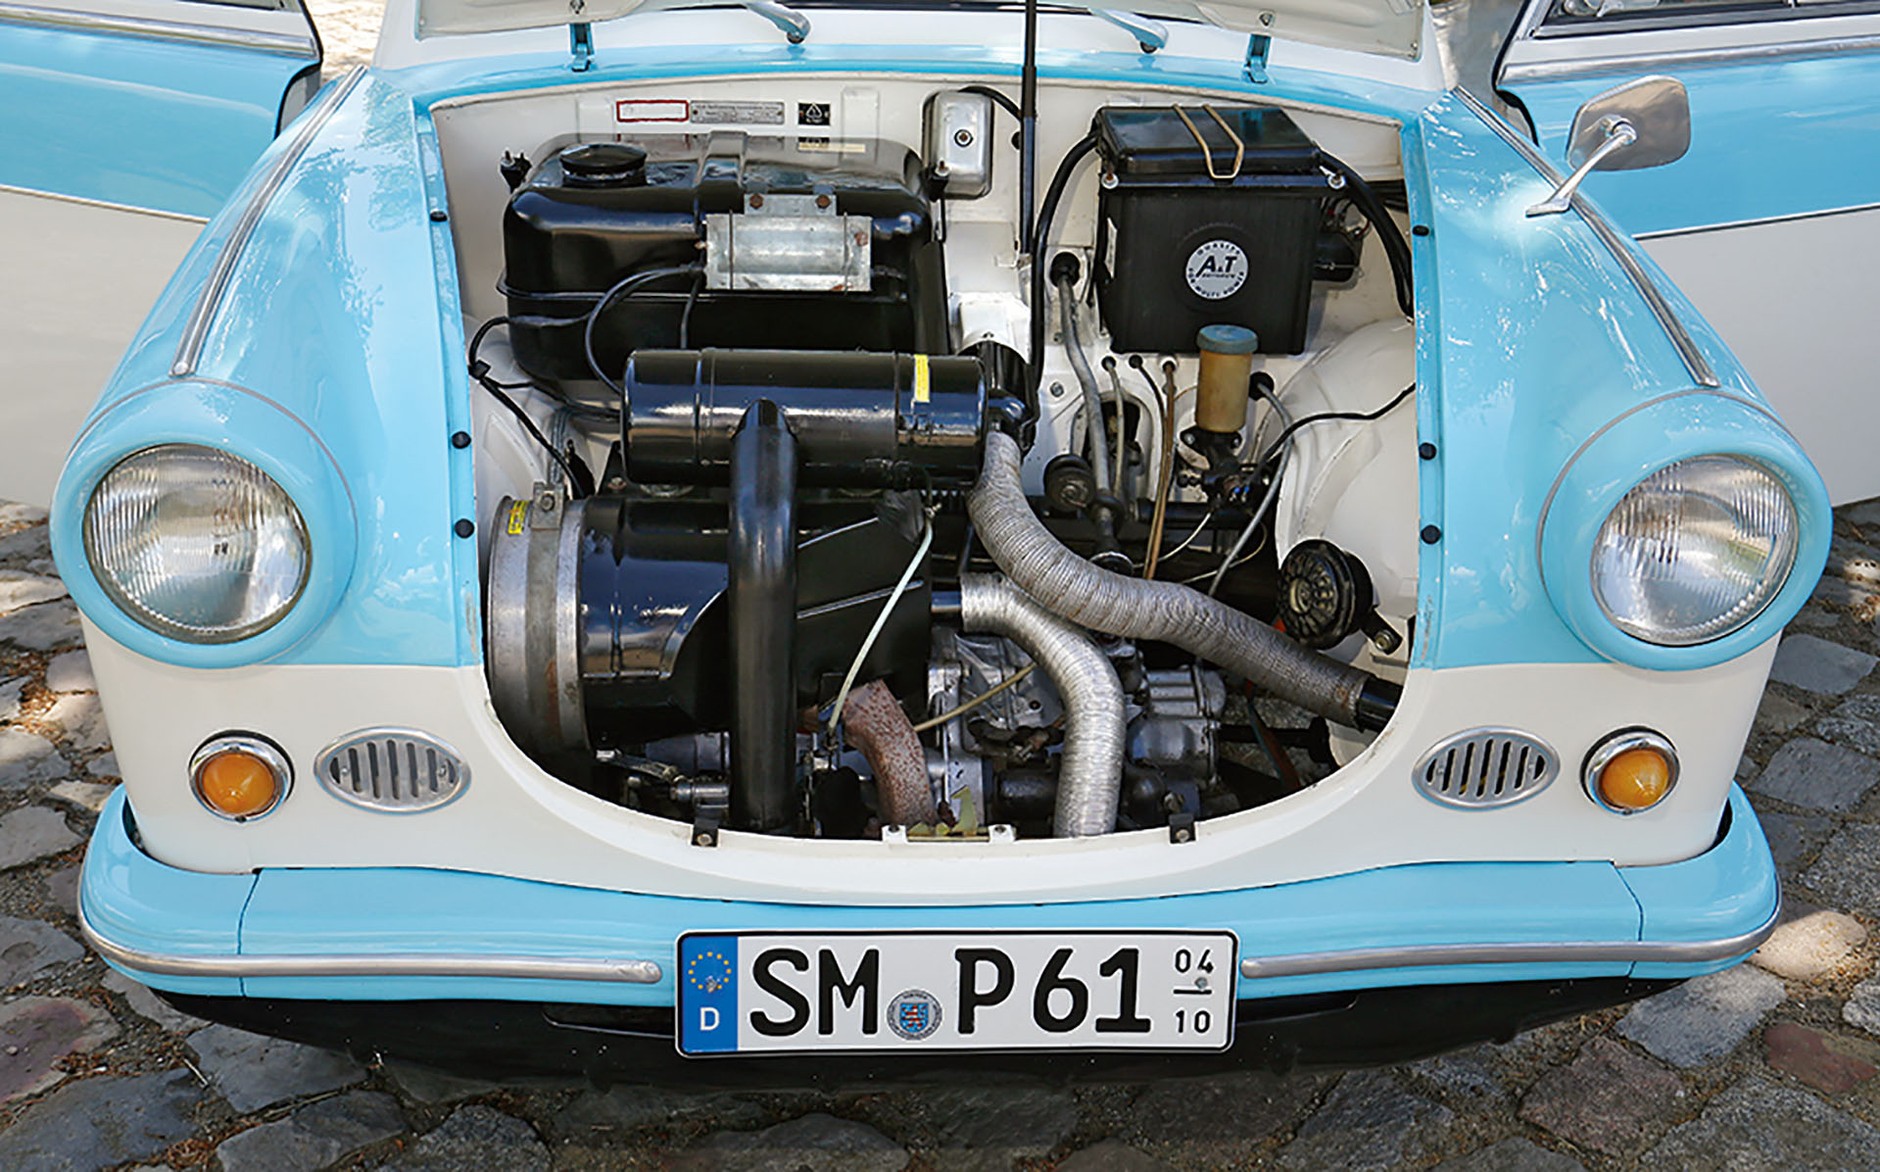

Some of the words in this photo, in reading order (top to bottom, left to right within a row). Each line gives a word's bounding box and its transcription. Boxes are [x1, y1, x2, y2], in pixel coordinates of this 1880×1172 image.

[1174, 949, 1214, 974] 04
[749, 948, 880, 1037] SM
[954, 948, 1015, 1035] P
[1033, 948, 1151, 1034] 61
[700, 1006, 720, 1031] D
[1175, 1010, 1211, 1034] 10
